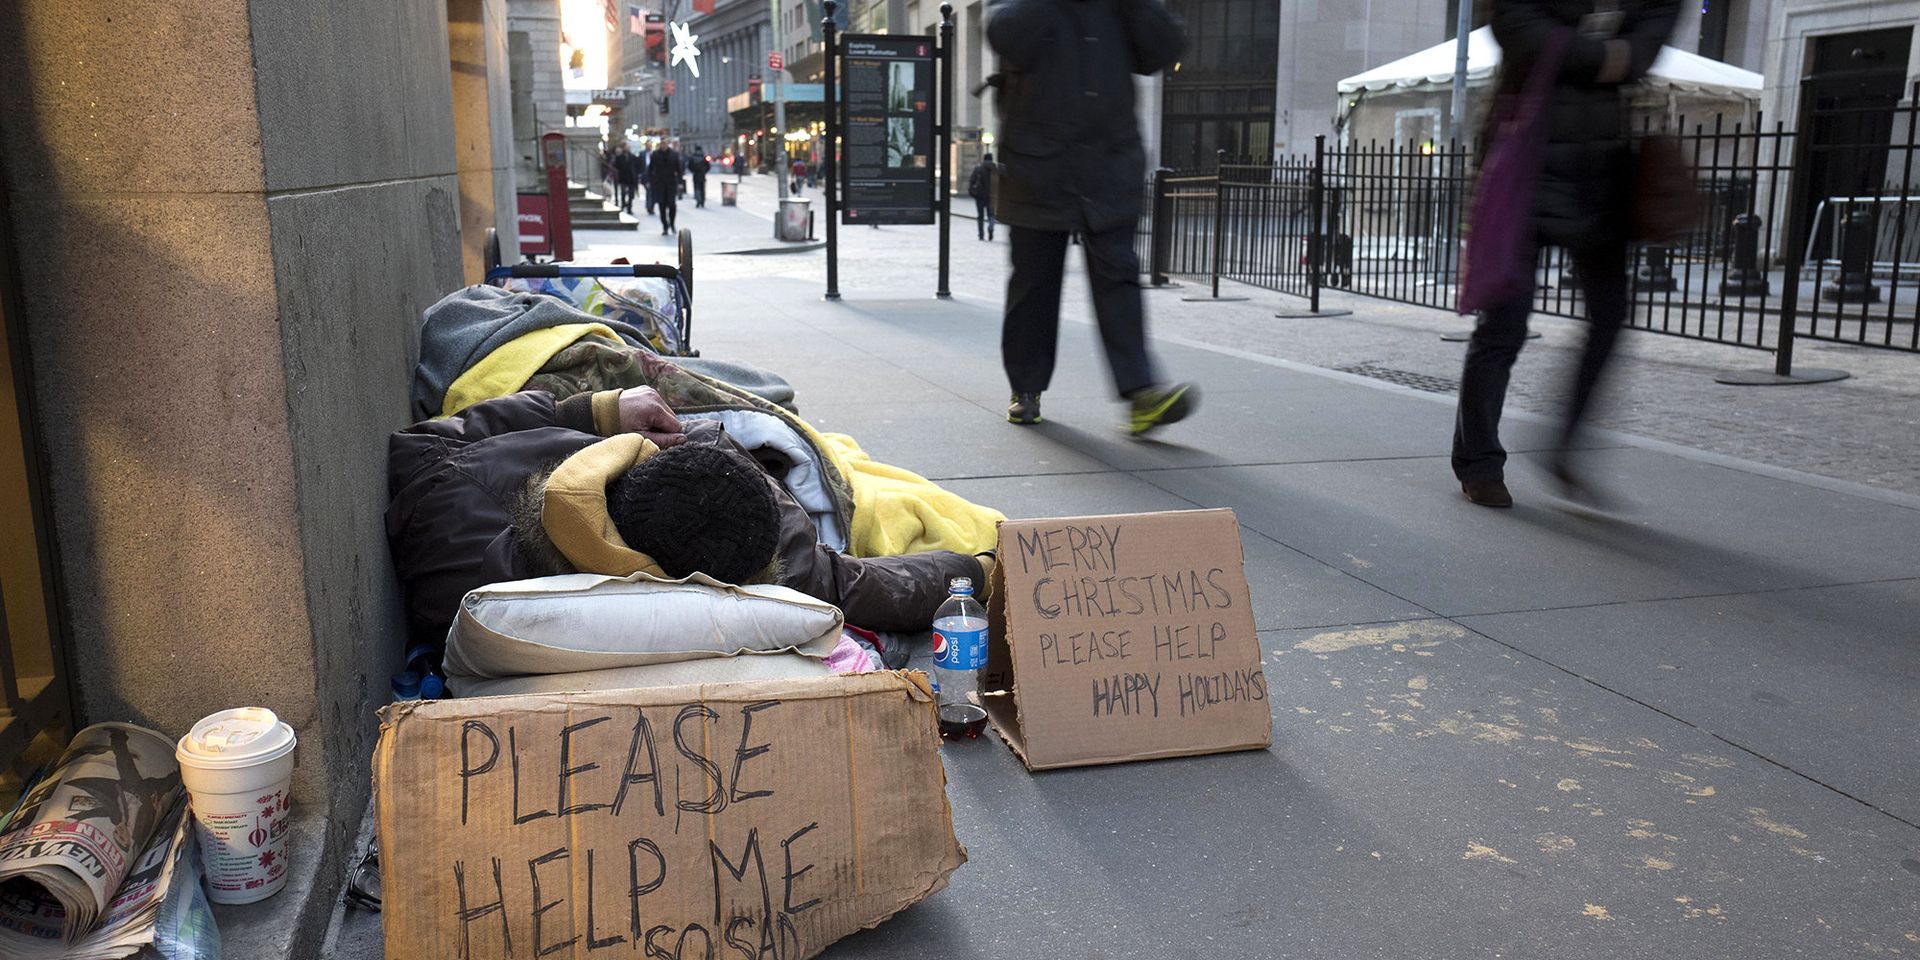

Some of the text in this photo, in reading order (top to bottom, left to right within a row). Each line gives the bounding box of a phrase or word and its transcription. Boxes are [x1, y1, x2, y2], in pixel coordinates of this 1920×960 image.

[1016, 525, 1121, 574] MERRY
[1032, 568, 1233, 619] CHRISTMAS
[951, 637, 960, 664] pepsi
[1039, 622, 1227, 668] PLEASE HELP
[1092, 667, 1265, 718] HAPPY HOLIDAYS
[460, 701, 781, 834] PLEASE
[39, 840, 104, 876] NEW
[454, 822, 825, 960] HELP ME
[645, 911, 800, 960] SO SAD
